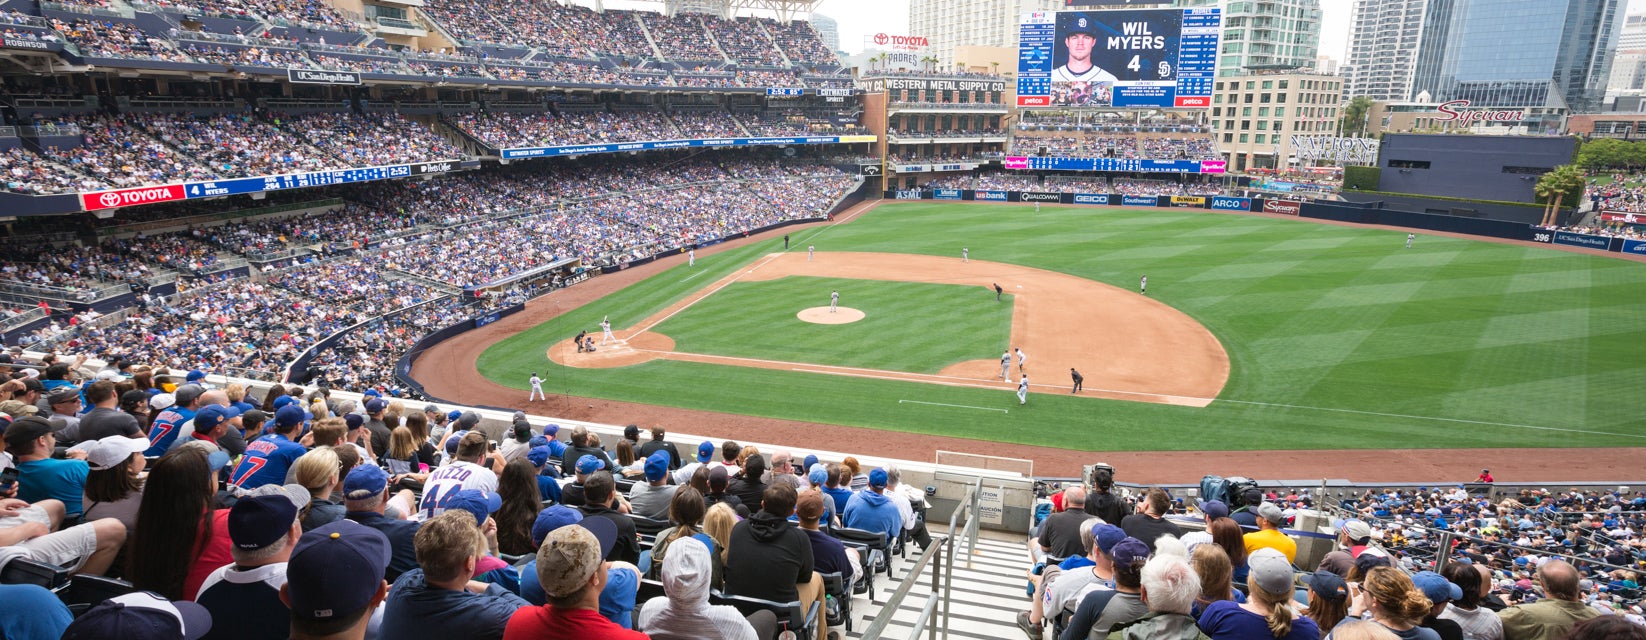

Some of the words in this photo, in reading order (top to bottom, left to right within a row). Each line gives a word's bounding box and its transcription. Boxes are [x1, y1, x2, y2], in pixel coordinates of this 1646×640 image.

[1122, 22, 1152, 35] WIL
[6, 39, 47, 48] ROBINSON
[891, 36, 928, 46] TOYOTA
[1107, 36, 1165, 49] MYERS
[888, 53, 918, 66] PADRES
[1128, 55, 1140, 72] 4
[320, 73, 336, 82] Diego
[886, 80, 926, 89] WESTERN
[930, 81, 957, 90] METAL
[959, 82, 989, 91] SUPPLY
[992, 83, 1005, 92] CO.
[1434, 100, 1524, 127] Sycuan
[1296, 149, 1375, 162] UNIVERSIT
[390, 167, 408, 175] 2:52
[439, 163, 451, 171] Coffee
[121, 188, 171, 203] TOYOTA
[191, 186, 199, 195] 4
[1022, 193, 1058, 201] QUALCOMM
[1268, 201, 1296, 212] Sycuan
[1534, 233, 1550, 242] 396
[227, 455, 268, 487] 17
[432, 467, 472, 481] RIZZO
[421, 484, 462, 518] 44
